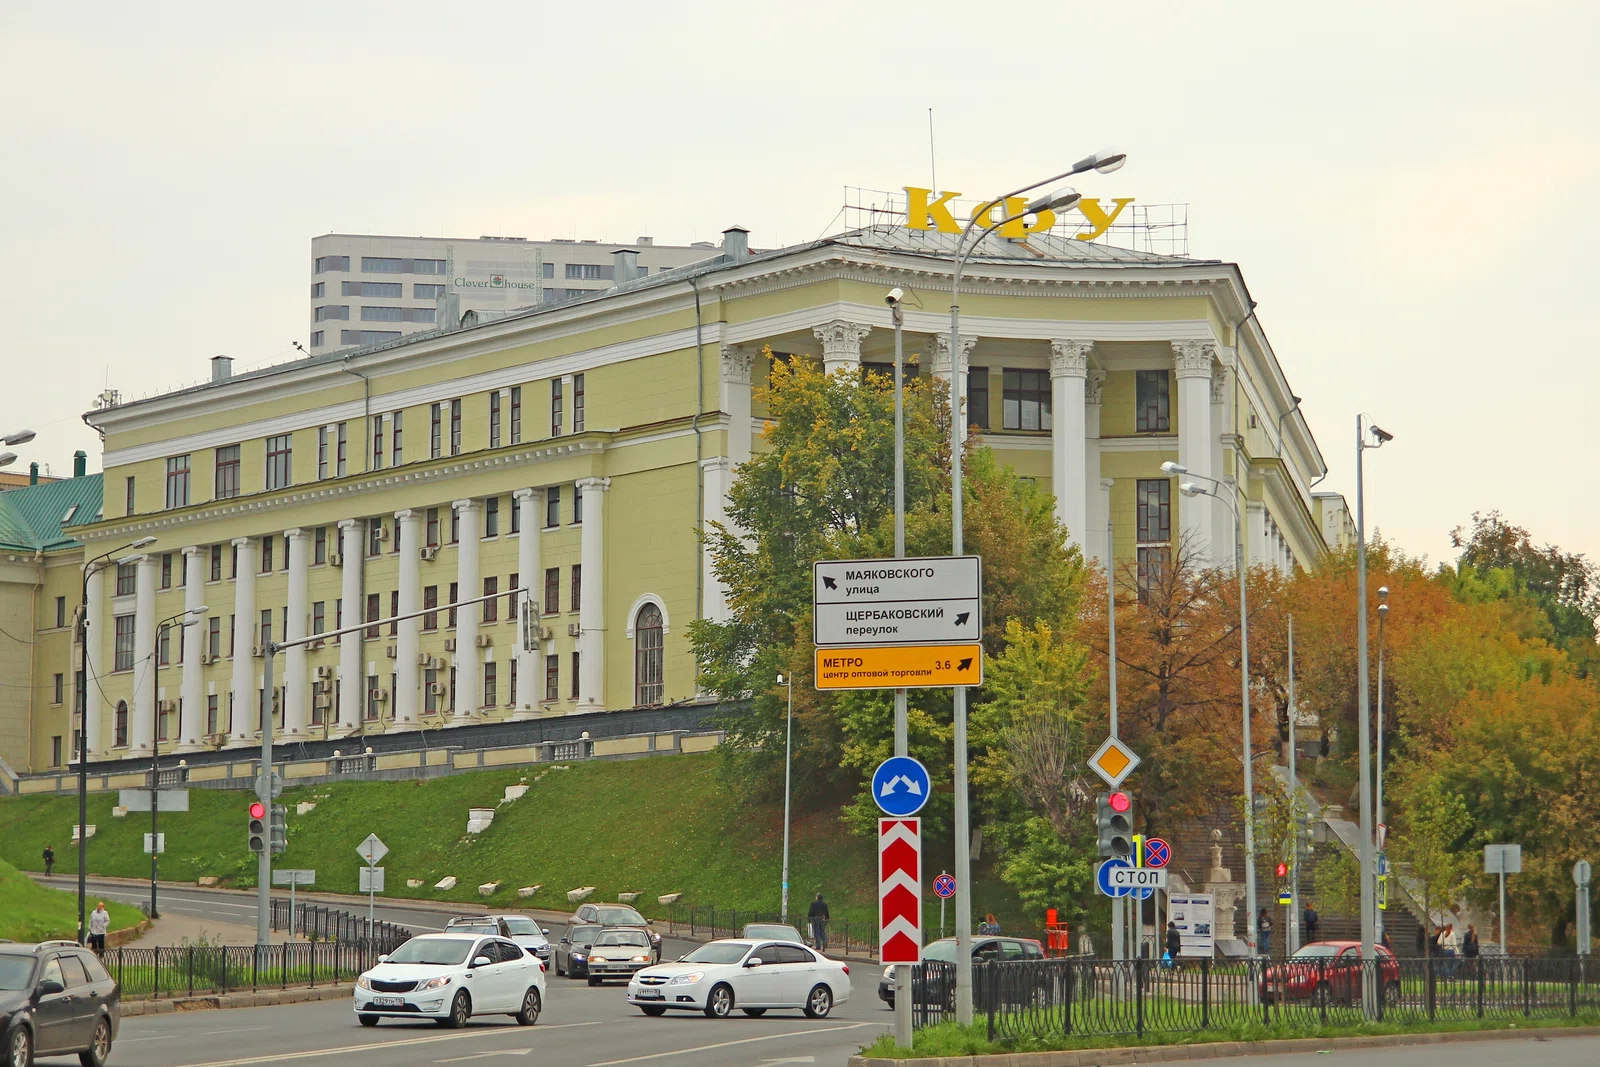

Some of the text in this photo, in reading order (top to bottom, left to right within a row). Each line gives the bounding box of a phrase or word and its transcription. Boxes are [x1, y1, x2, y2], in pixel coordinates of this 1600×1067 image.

[504, 279, 535, 290] house
[845, 568, 935, 580] МАЯКОВСКОГО
[845, 585, 880, 596] улица
[846, 607, 944, 621] ЩЕРБАКОВСКИЙ
[846, 626, 898, 635] переулок
[823, 658, 863, 667] МЕТРО
[935, 661, 951, 670] 3.6
[823, 669, 932, 679] центр оптовой торговли
[1115, 871, 1158, 884] СТОП
